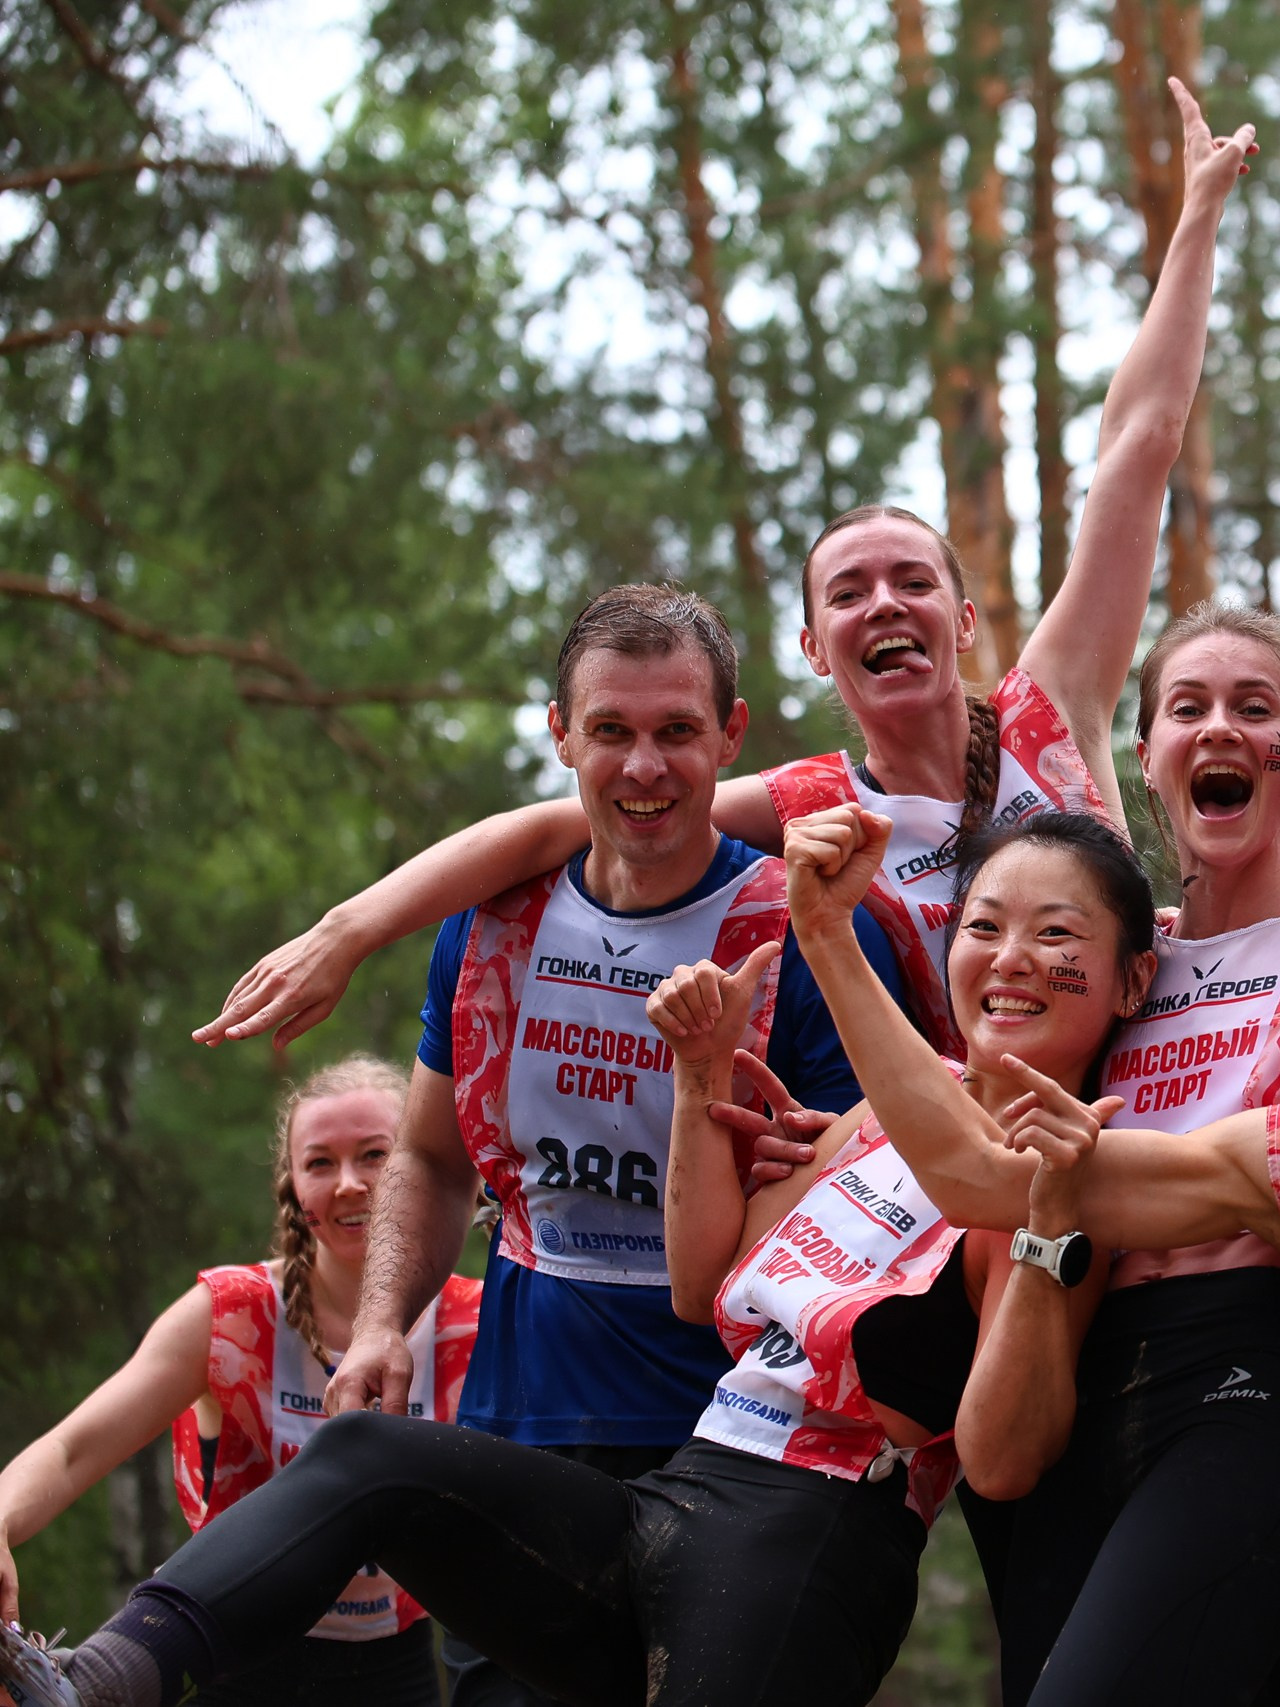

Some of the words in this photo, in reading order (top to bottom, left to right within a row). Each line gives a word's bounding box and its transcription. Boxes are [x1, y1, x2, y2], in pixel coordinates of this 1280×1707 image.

[894, 844, 958, 881] ГОНК
[537, 956, 602, 982] ГОНКА
[609, 966, 674, 992] ГЕРО
[1049, 966, 1087, 982] ГОНКА
[1141, 991, 1192, 1018] ОНКА
[1194, 974, 1279, 1002] ГЕРОЕВ
[1106, 1017, 1262, 1087] МАССОВЫЙ
[555, 1061, 638, 1107] СТАРТ
[1133, 1069, 1213, 1115] СТАРТ
[535, 1136, 658, 1209] 886
[835, 1170, 878, 1208] ГОНКА
[570, 1231, 666, 1253] ГАЗПРОМБ
[1203, 1389, 1272, 1403] DEMIX
